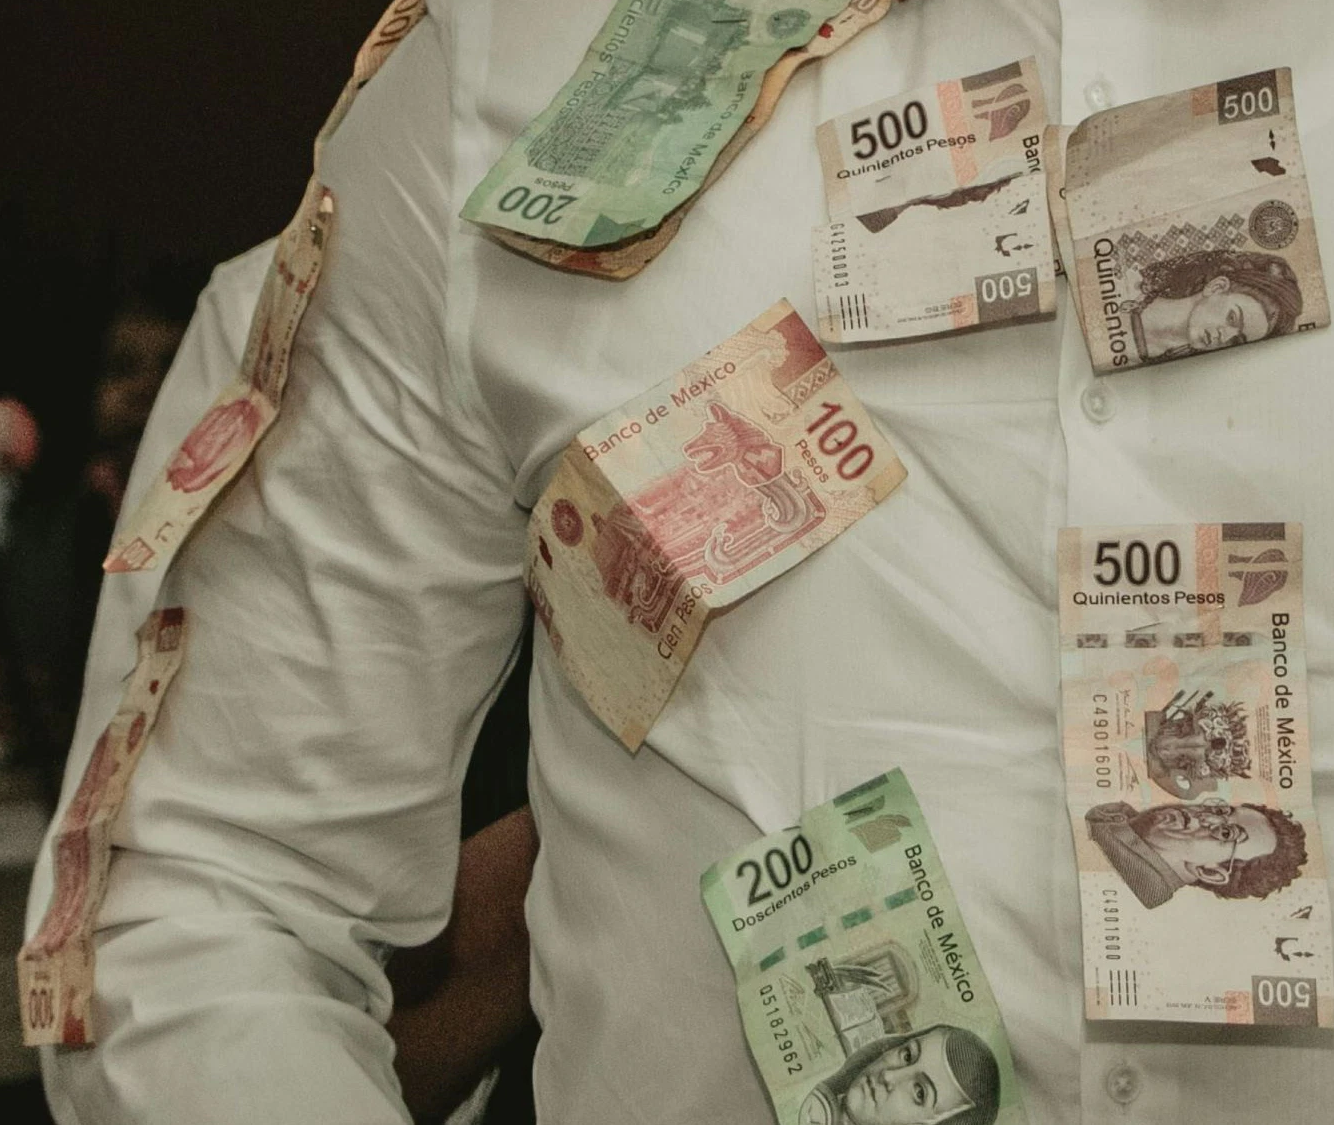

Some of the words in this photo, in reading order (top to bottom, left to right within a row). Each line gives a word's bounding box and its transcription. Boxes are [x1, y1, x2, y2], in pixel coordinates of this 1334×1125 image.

[559, 69, 605, 119] Pesos
[721, 69, 756, 121] Banco
[1224, 87, 1274, 120] 500
[709, 123, 727, 143] de
[836, 143, 924, 180] Quinientos
[926, 132, 977, 152] Pesos
[851, 100, 928, 160] 500
[534, 176, 573, 192] Pesos
[662, 141, 711, 195] México
[498, 185, 578, 225] 200
[981, 271, 1033, 303] 500
[1093, 237, 1128, 368] Quinientos
[582, 420, 643, 464] Banco
[645, 403, 670, 427] de
[804, 399, 876, 483] 100
[794, 437, 831, 486] Pesos
[1092, 539, 1183, 586] 500
[657, 624, 682, 661] Cien
[674, 582, 714, 625] Pesos
[1072, 590, 1171, 607] Quinientos
[1174, 590, 1226, 605] Pesos
[1270, 612, 1291, 679] Banco
[1274, 683, 1294, 710] de
[1092, 693, 1112, 789] C4901600
[1275, 717, 1298, 790] México
[731, 879, 811, 932] Doscientos
[810, 855, 858, 886] Pesos
[735, 833, 814, 908] 200
[904, 843, 935, 903] Banco
[925, 903, 946, 931] de
[937, 931, 975, 1004] México
[1257, 979, 1312, 1008] 500
[759, 984, 803, 1076] Q5182962
